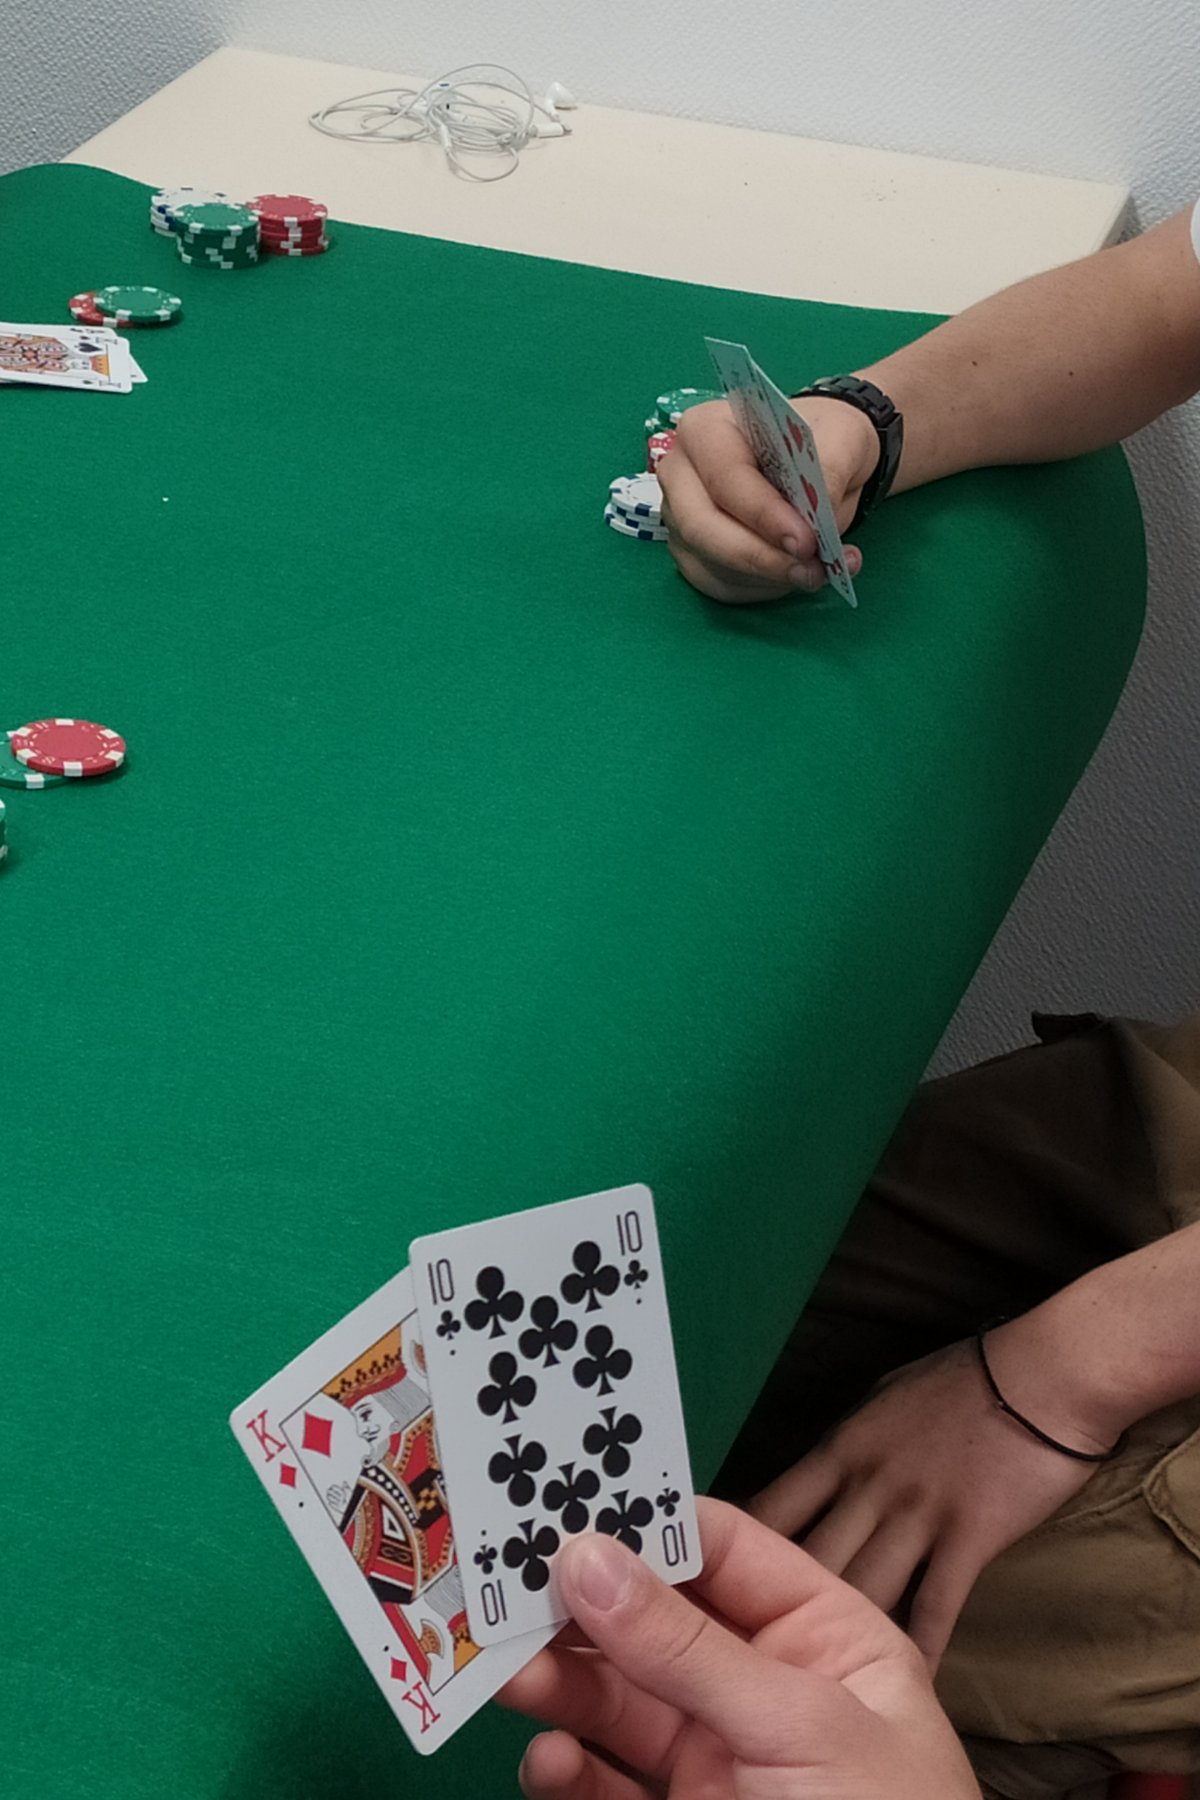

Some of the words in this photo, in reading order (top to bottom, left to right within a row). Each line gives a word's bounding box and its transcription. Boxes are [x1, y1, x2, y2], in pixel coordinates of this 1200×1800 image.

[616, 1210, 644, 1256] 10
[427, 1257, 455, 1305] 10
[246, 1410, 288, 1463] K
[661, 1521, 688, 1568] 10
[479, 1578, 508, 1627] 10
[401, 1680, 442, 1734] K
